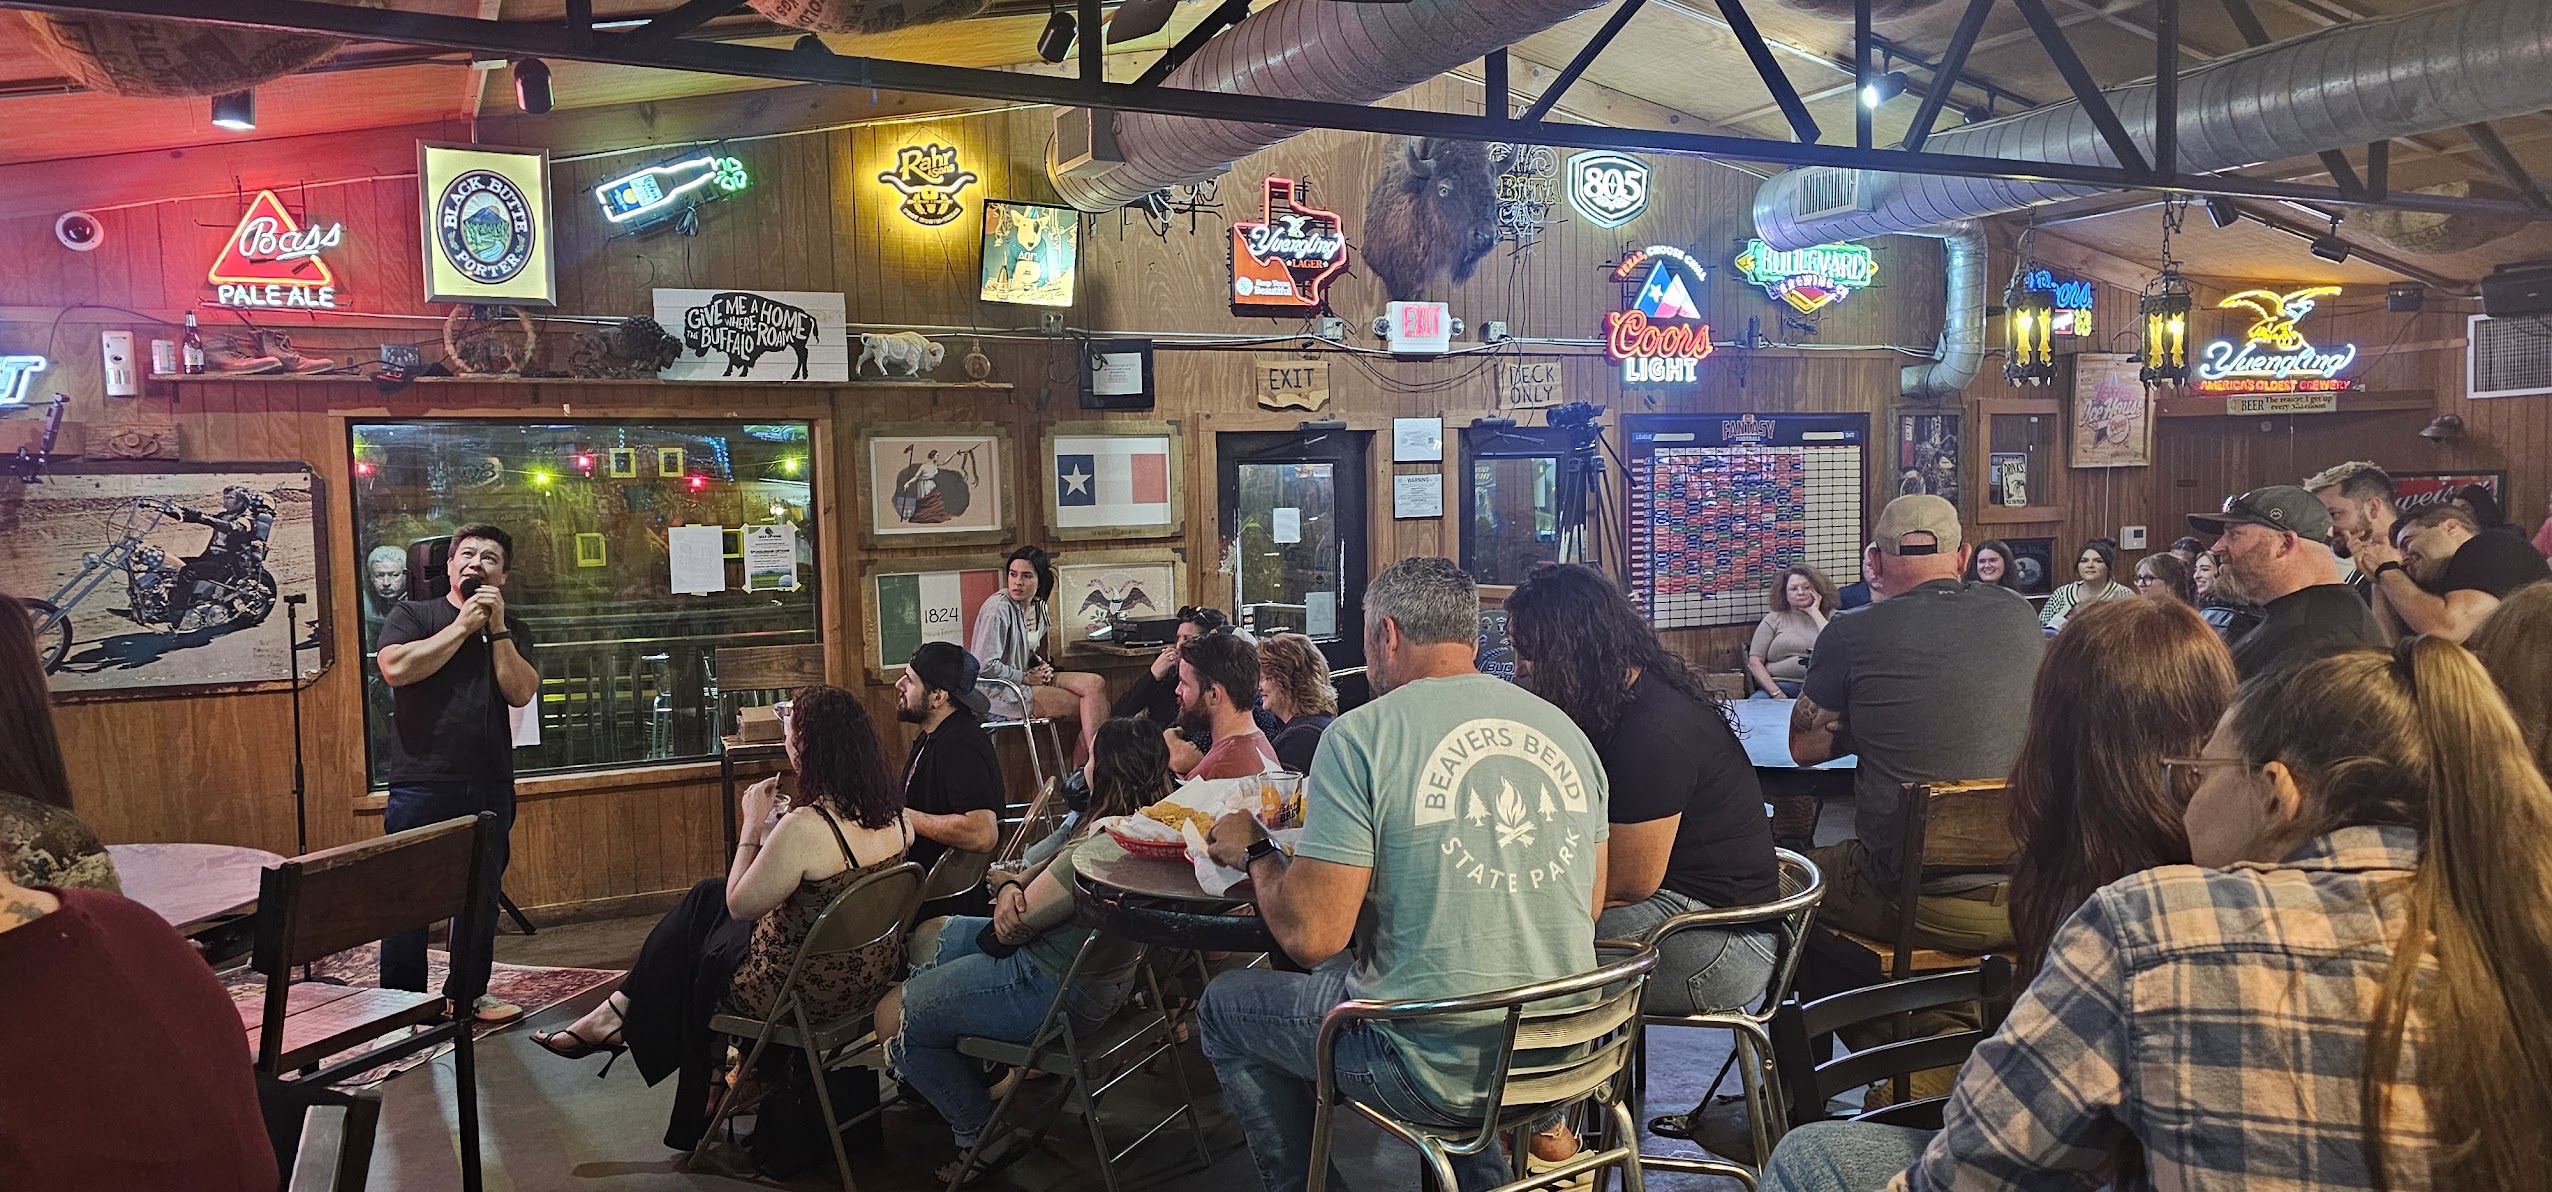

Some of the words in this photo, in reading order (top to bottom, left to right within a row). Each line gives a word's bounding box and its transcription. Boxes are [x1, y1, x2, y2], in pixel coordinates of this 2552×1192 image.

[900, 147, 954, 184] Rahr
[1497, 175, 1562, 204] BITA
[1583, 167, 1642, 202] 805
[444, 176, 485, 229] BLACK
[487, 177, 528, 233] BUTTE
[238, 216, 342, 261] Bass
[1249, 226, 1346, 260] Yuengling
[455, 249, 520, 278] PORTER
[1292, 259, 1323, 269] LAGER
[218, 284, 283, 305] PALE
[287, 286, 335, 307] ALE
[687, 299, 724, 329] GIVE
[725, 295, 748, 315] ME
[750, 299, 759, 314] A
[760, 300, 808, 340] HOME
[724, 314, 758, 333] WHERE
[1402, 305, 1442, 338] EXIT
[686, 329, 699, 340] THE
[700, 326, 755, 361] BUFFALO
[756, 322, 794, 348] ROAM
[1609, 309, 1713, 359] Coors
[1624, 356, 1699, 382] LIGHT
[2199, 341, 2357, 379] Yuengling
[1269, 367, 1315, 390] EXIT
[1509, 365, 1555, 386] DECK
[2199, 378, 2255, 392] AMERICA'S
[2255, 379, 2298, 392] OLDEST
[2299, 379, 2351, 392] BREWERY
[1510, 386, 1553, 404] ONLY
[2241, 399, 2265, 412] BEER
[2270, 403, 2290, 411] every
[1721, 420, 1776, 440] FANTASY
[924, 607, 959, 624] 1824
[1487, 661, 1515, 673] BUD
[1425, 727, 1513, 810] BEAVERS
[1523, 733, 1580, 800] BEND
[1441, 836, 1518, 893] STATE
[1529, 826, 1581, 889] PARK
